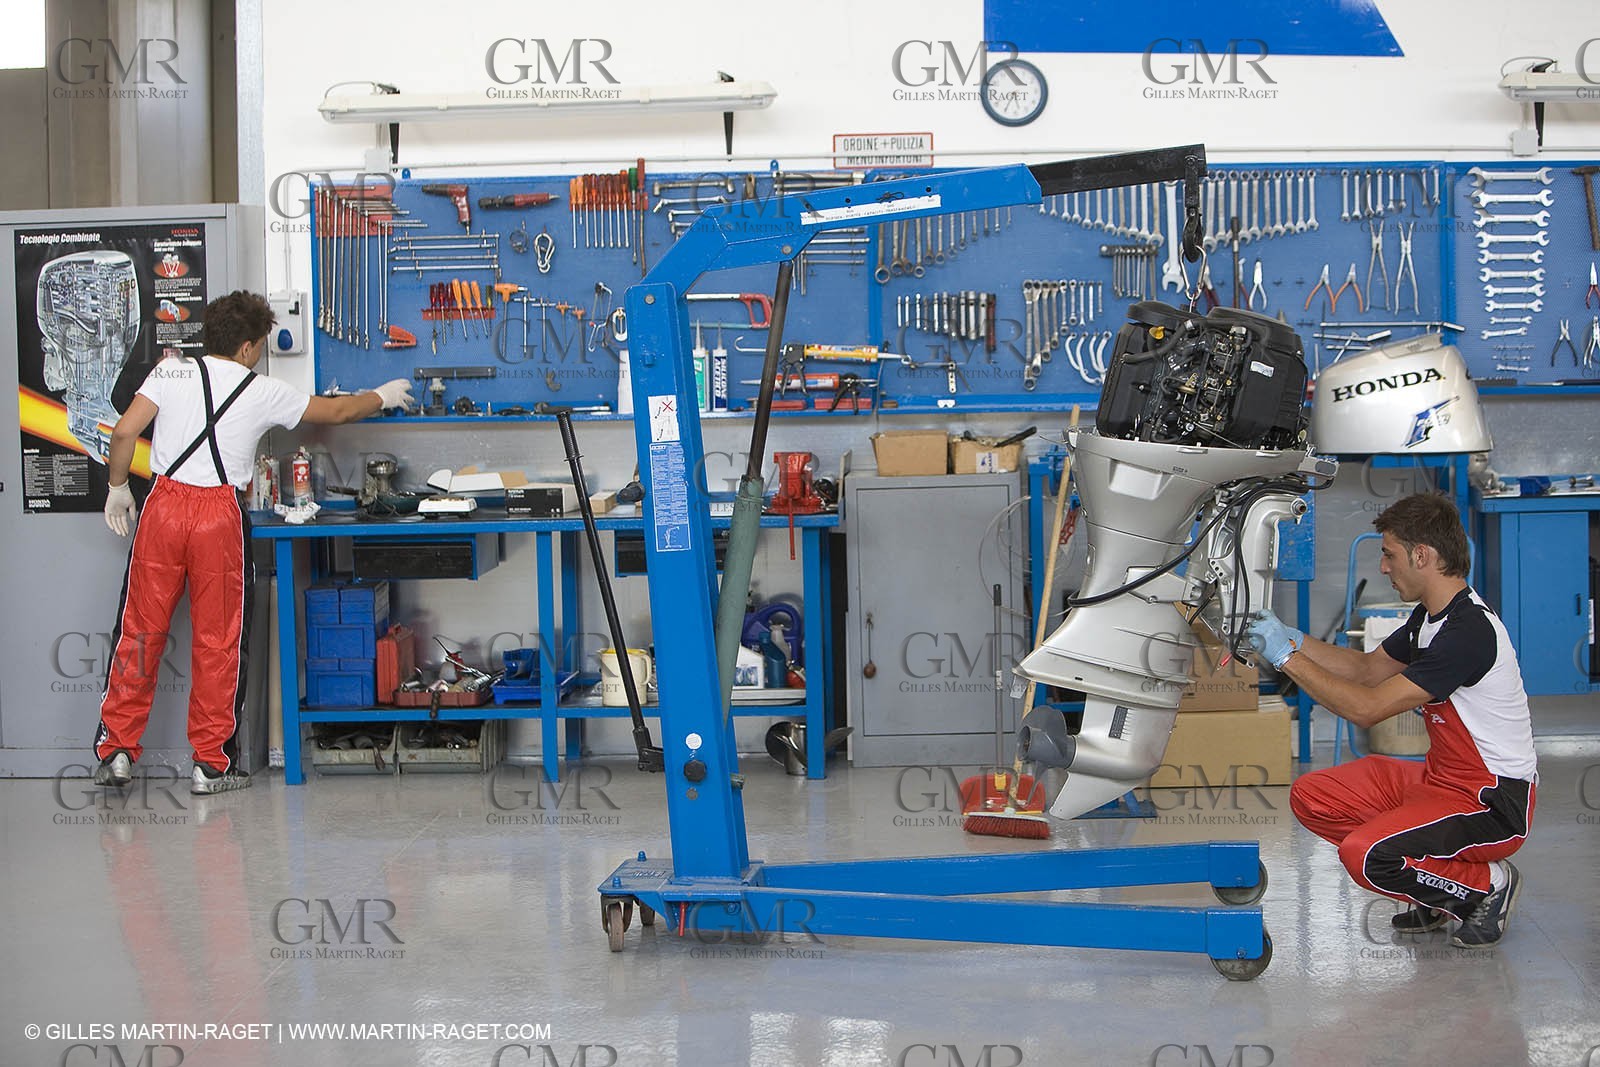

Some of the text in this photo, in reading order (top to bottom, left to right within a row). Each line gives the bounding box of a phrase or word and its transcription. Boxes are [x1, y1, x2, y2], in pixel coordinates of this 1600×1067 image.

[843, 138, 879, 151] ORDINE
[891, 136, 924, 149] PULIZIA
[61, 232, 101, 243] Combinate
[1332, 368, 1443, 402] HONDA
[1416, 871, 1470, 900] HONDA
